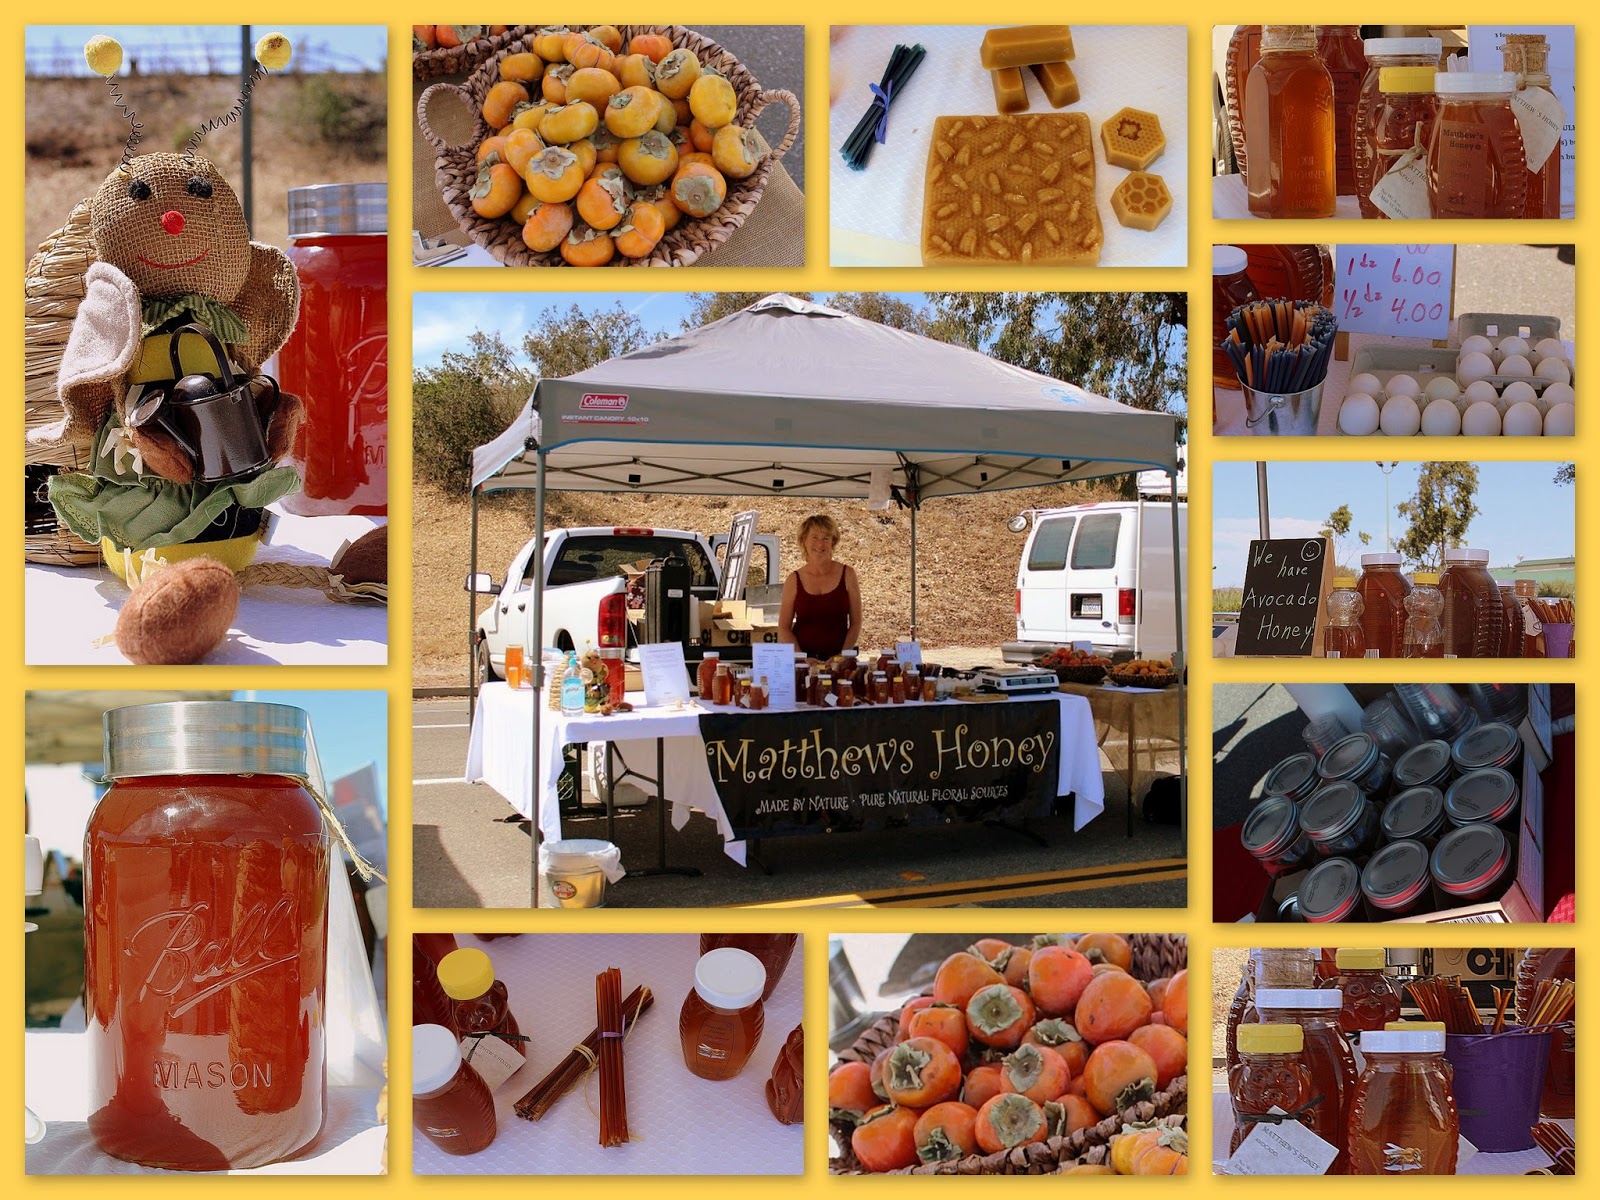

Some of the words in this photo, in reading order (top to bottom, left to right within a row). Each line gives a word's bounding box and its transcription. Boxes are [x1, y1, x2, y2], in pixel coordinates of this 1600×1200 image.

[1442, 128, 1485, 140] Matthew's
[1347, 257, 1355, 276] 1
[1359, 252, 1377, 268] dz
[1391, 257, 1442, 285] 6.00
[1363, 282, 1383, 303] dz
[1391, 297, 1443, 324] 4.00
[583, 395, 618, 406] Coleman
[593, 414, 626, 422] CANOPY
[1253, 541, 1273, 568] We
[1276, 554, 1308, 578] have
[1241, 582, 1318, 608] Avocado
[705, 728, 915, 784] Matthews
[929, 723, 1055, 780] Honey
[755, 799, 790, 815] MADE
[793, 798, 807, 812] BY
[808, 795, 850, 811] NATURE
[859, 792, 886, 808] PURE
[888, 789, 930, 806] NATURAL
[932, 786, 970, 803] FLORAL
[970, 784, 1009, 800] SOURCES
[123, 897, 299, 1010] Ball
[152, 1059, 273, 1091] MASON
